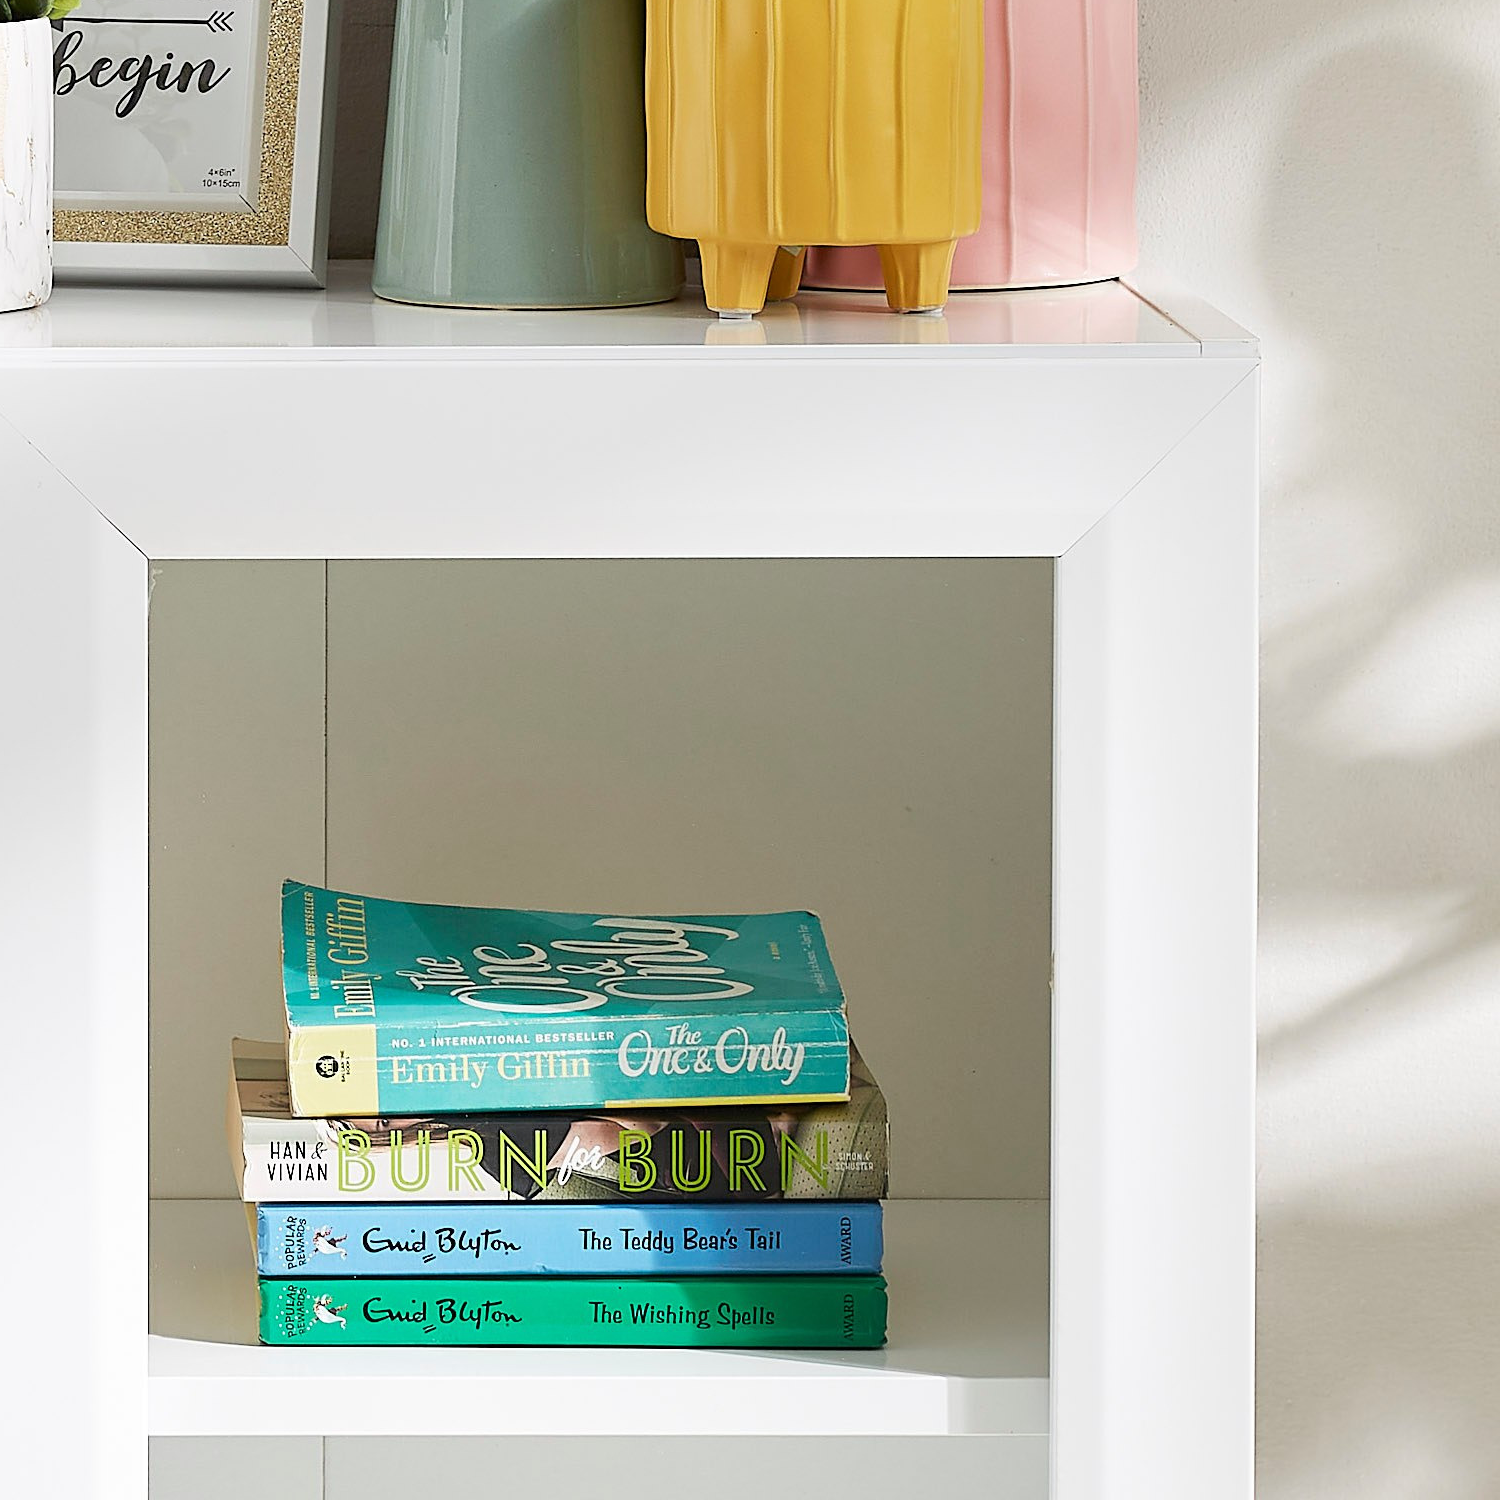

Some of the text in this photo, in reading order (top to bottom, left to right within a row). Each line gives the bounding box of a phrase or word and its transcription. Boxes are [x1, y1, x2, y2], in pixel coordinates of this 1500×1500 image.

[53, 30, 231, 118] begin
[304, 891, 316, 937] BESTSELLER
[306, 938, 319, 987] INTERNATIONAL
[325, 897, 382, 1019] Emily Giffin
[395, 955, 477, 992] The
[450, 942, 609, 1014] One
[549, 917, 755, 1001] Only
[556, 957, 626, 978] &
[391, 1030, 616, 1049] NO. 1 INTERNATIONAL BESTSELLER
[617, 1025, 806, 1086] One & Only
[665, 1022, 703, 1047] The
[390, 1050, 591, 1088] Emily Giffin
[267, 1163, 329, 1182] VIVIAN
[270, 1140, 328, 1160] HAN &
[337, 1128, 829, 1193] BURN for BURN
[835, 1161, 874, 1171] SCHUSTER
[838, 1152, 862, 1161] SIMON
[286, 1215, 299, 1270] POPULAR
[298, 1217, 308, 1268] REWARDS
[362, 1227, 522, 1259] Enid Blyton
[578, 1227, 782, 1254] The Teddy Bear's Tail
[840, 1216, 853, 1265] AWARD
[286, 1283, 299, 1339] POPULAR
[297, 1286, 308, 1336] REWARDS
[362, 1296, 523, 1330] Enid Blyton
[588, 1301, 776, 1330] The Wishing Spells
[843, 1293, 855, 1341] AWARD
